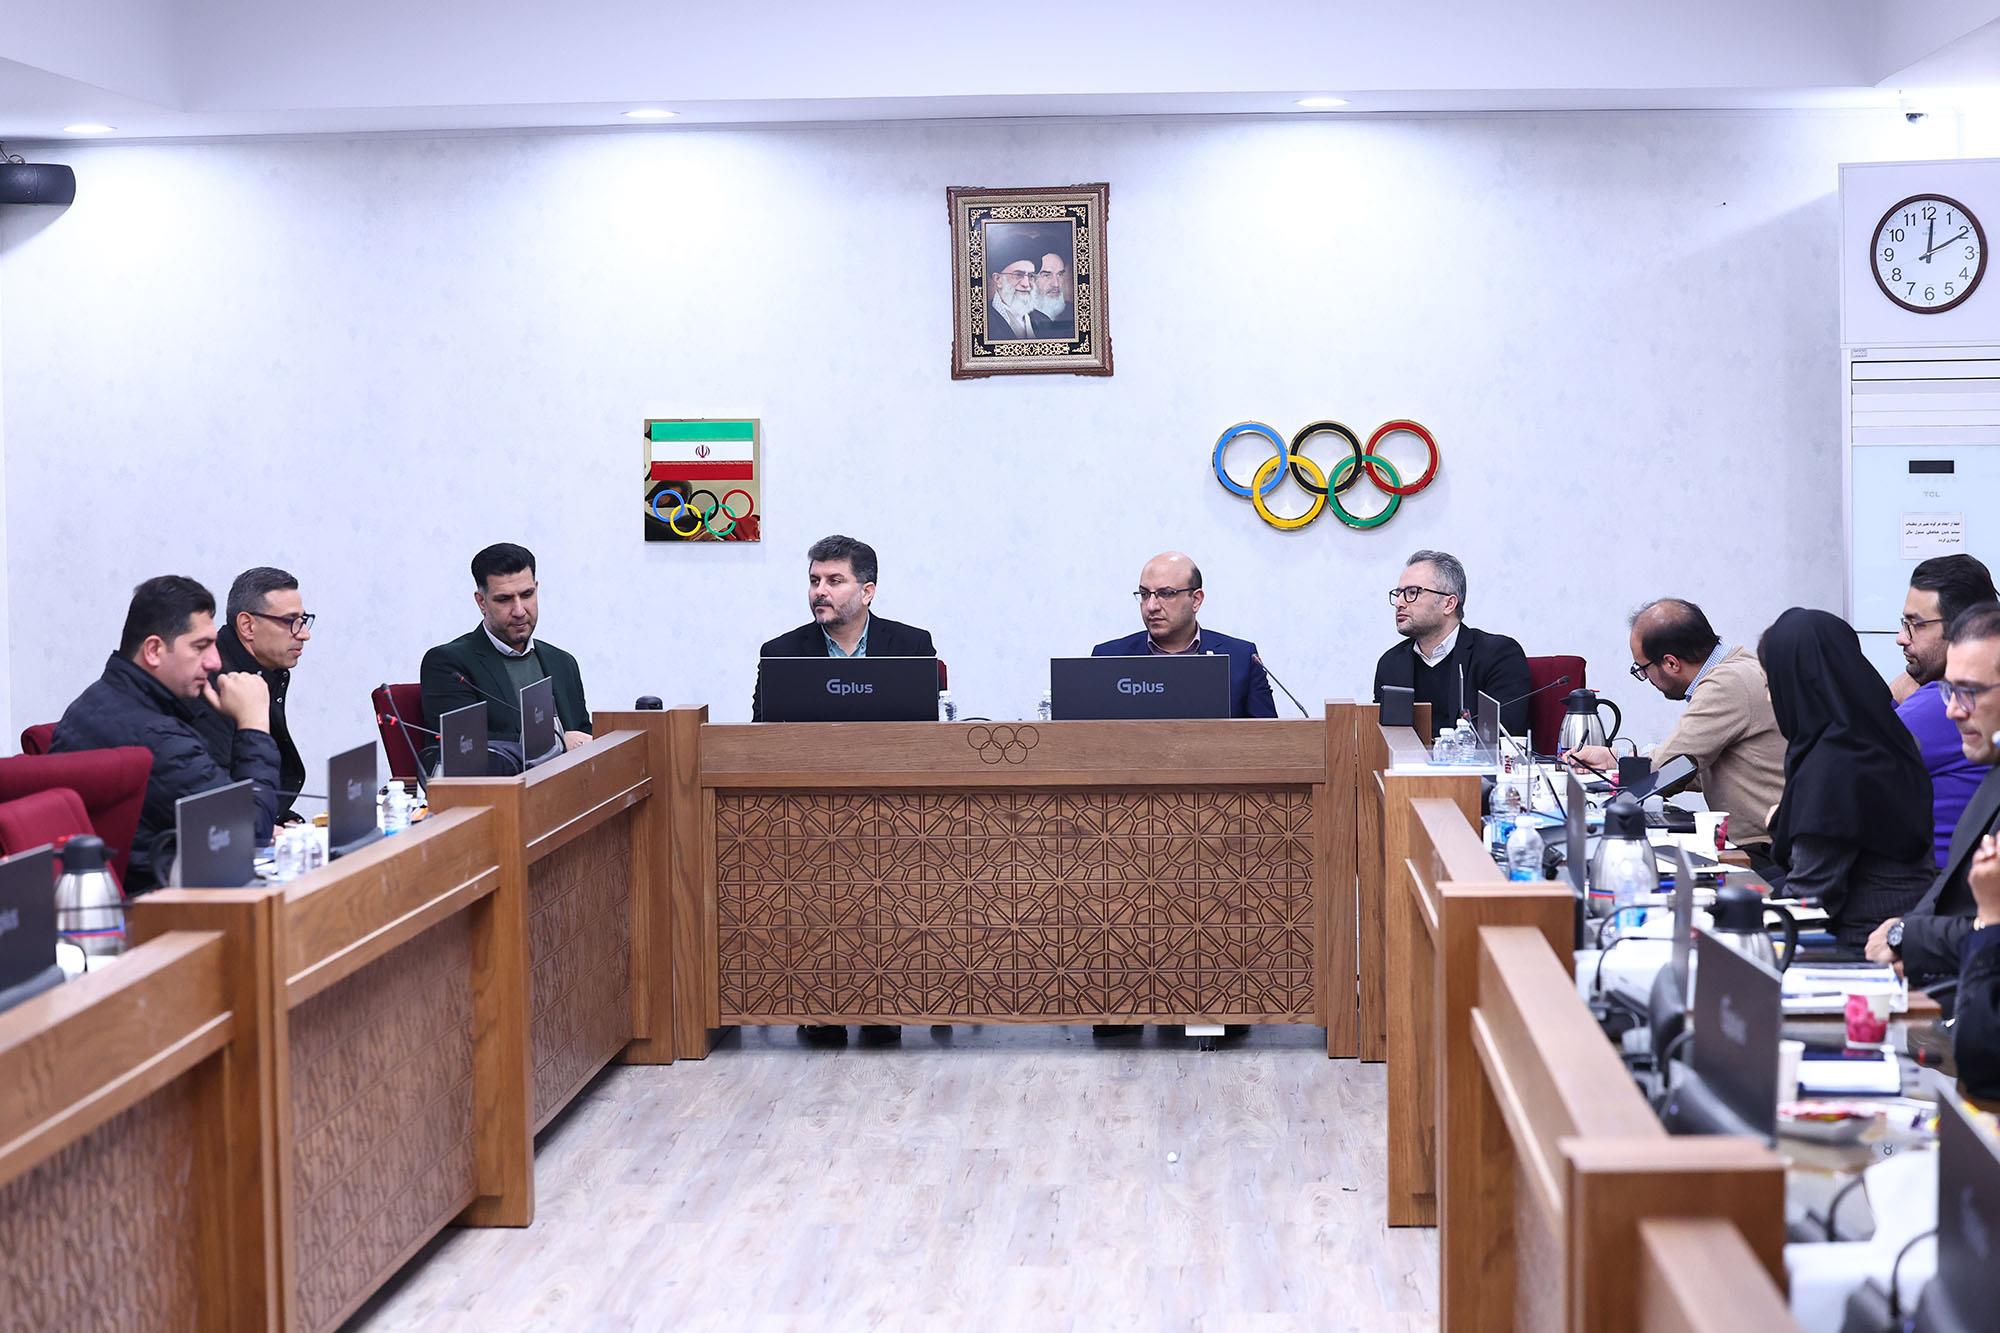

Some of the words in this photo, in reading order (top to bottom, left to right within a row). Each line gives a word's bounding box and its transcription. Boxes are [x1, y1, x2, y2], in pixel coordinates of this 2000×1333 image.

[1903, 212, 1916, 227] 11
[1921, 206, 1937, 221] 12
[1946, 211, 1952, 226] 1
[1888, 228, 1905, 243] 10
[1958, 225, 1970, 240] 2
[1883, 247, 1895, 262] 9
[1964, 245, 1975, 260] 3
[1891, 267, 1902, 282] 8
[1958, 266, 1969, 280] 4
[1906, 281, 1916, 296] 7
[1924, 286, 1935, 301] 6
[1944, 281, 1954, 296] 5
[826, 679, 874, 696] Gplus
[1117, 678, 1165, 695] Gplus
